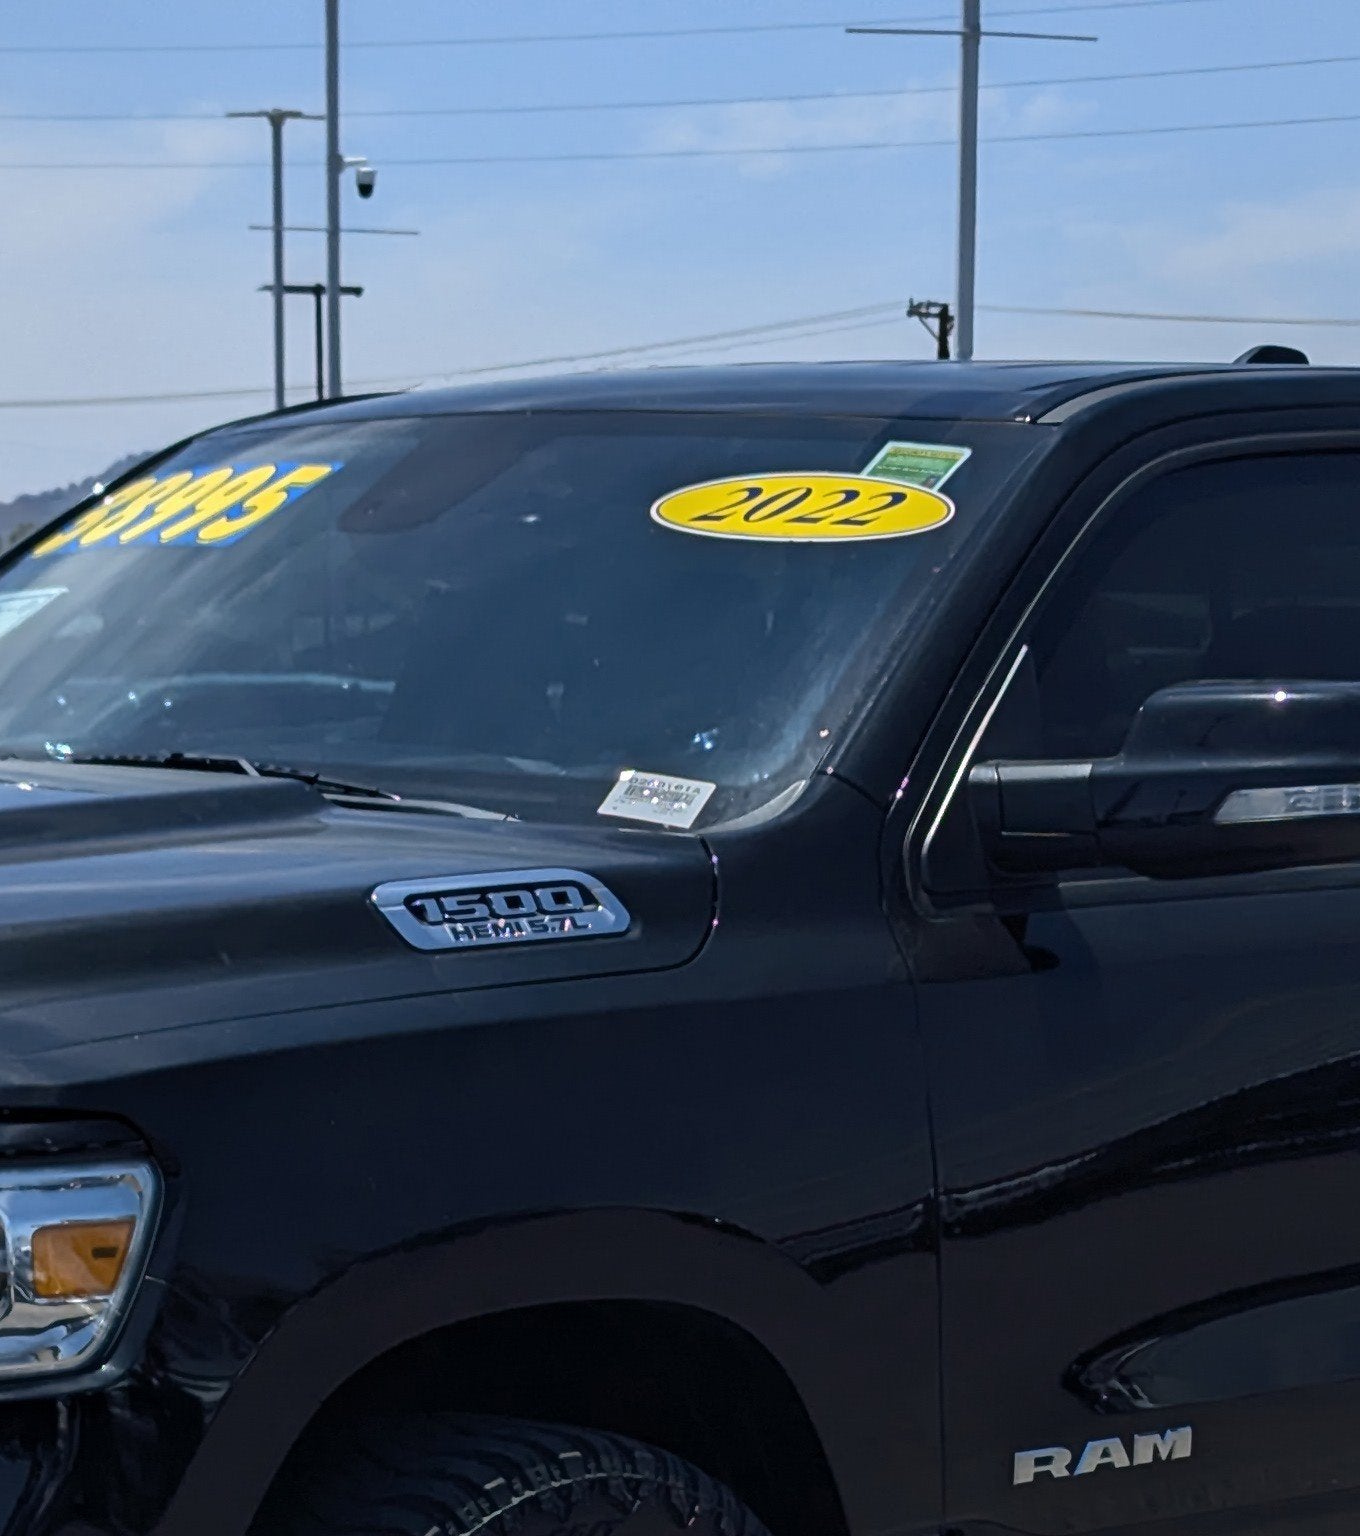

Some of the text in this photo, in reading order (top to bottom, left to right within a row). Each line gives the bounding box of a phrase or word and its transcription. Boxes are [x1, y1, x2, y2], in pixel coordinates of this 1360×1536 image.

[689, 486, 909, 527] 2022
[410, 885, 585, 923] 1500
[448, 915, 591, 942] HEMI 5.7L
[1012, 1425, 1193, 1486] RAM
